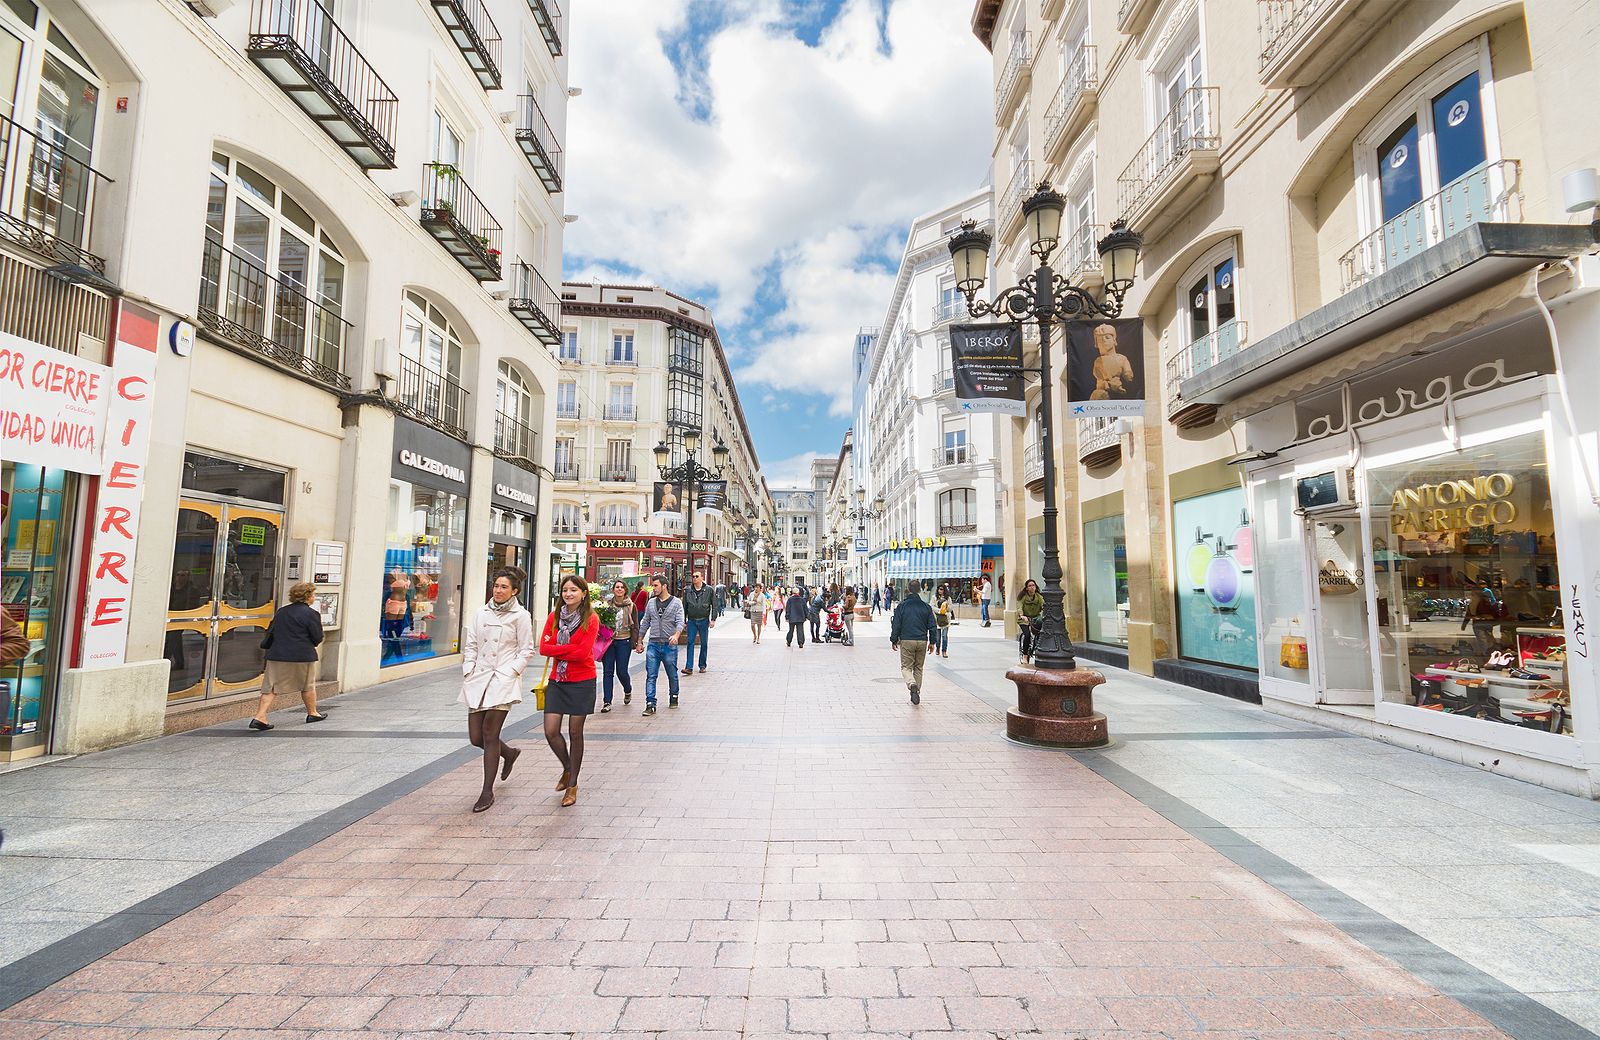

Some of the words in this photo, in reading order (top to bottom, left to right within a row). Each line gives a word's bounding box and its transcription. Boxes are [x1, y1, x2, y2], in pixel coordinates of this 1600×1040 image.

[965, 336, 1009, 347] IBEROS
[32, 360, 100, 404] CIERRE
[0, 410, 46, 445] IDAD
[399, 449, 465, 483] CALZEDONIA
[302, 481, 313, 494] 16
[1391, 472, 1514, 511] ANTONIO
[91, 376, 148, 627] CIERRE
[496, 483, 536, 507] CALZEDONIA
[595, 540, 646, 548] JOYERIA
[662, 541, 684, 550] MARTIN
[889, 537, 946, 550] DERBY
[1319, 569, 1364, 577] ANTONIO
[1319, 577, 1364, 586] PARRIEGO
